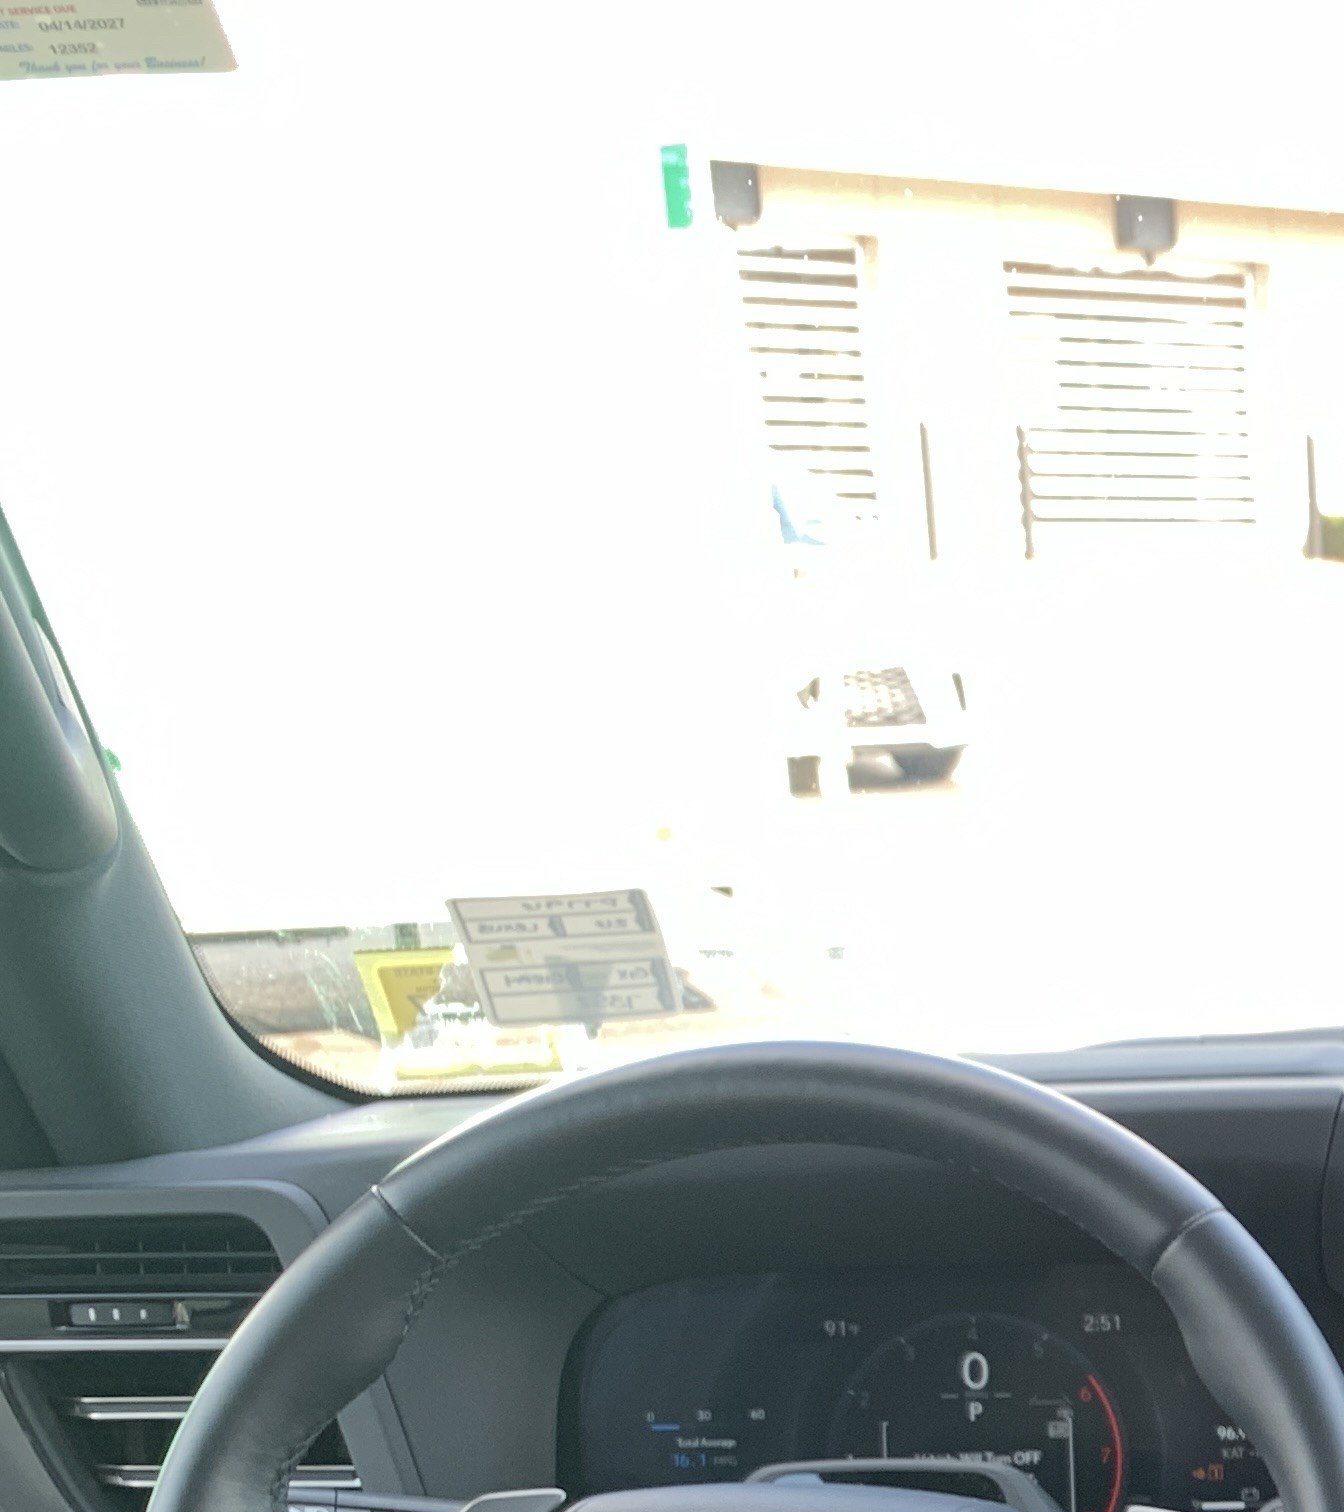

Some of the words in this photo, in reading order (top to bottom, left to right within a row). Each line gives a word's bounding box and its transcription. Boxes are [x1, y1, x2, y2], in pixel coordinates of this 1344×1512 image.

[38, 18, 125, 31] 04/14/2027
[49, 43, 98, 55] 12352
[1083, 1314, 1121, 1333] 2:51
[962, 1351, 989, 1390] 0
[968, 1401, 983, 1422] P
[1013, 1449, 1042, 1466] OFF
